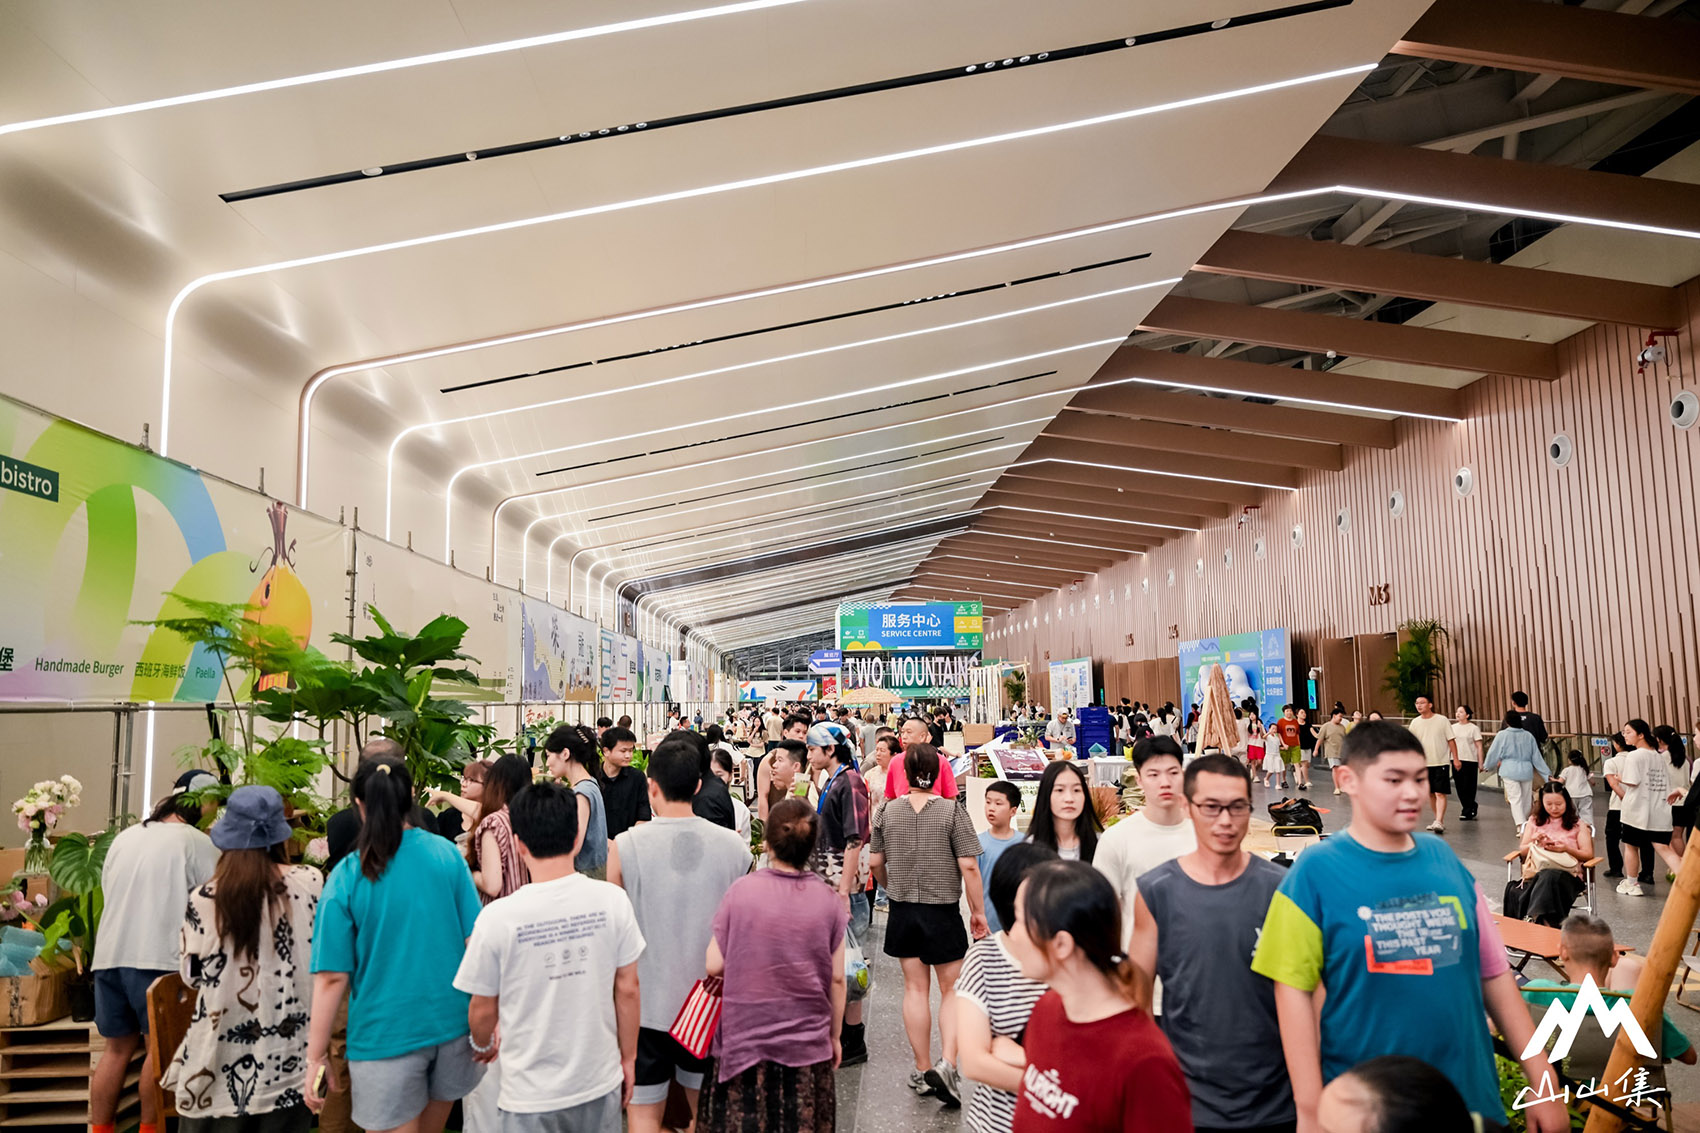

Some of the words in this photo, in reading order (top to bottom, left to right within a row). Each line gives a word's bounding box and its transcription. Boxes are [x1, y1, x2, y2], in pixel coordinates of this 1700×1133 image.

[1, 460, 53, 496] bistro
[881, 613, 942, 629] 服务中心
[881, 630, 912, 638] SERVICE
[913, 629, 942, 637] CENTRE
[35, 657, 91, 674] Handmade
[93, 660, 124, 678] Burger
[135, 661, 186, 679] 西班牙海鲜饭
[195, 666, 216, 679] Paella
[846, 656, 884, 688] TWO
[1413, 945, 1442, 956] YEAR
